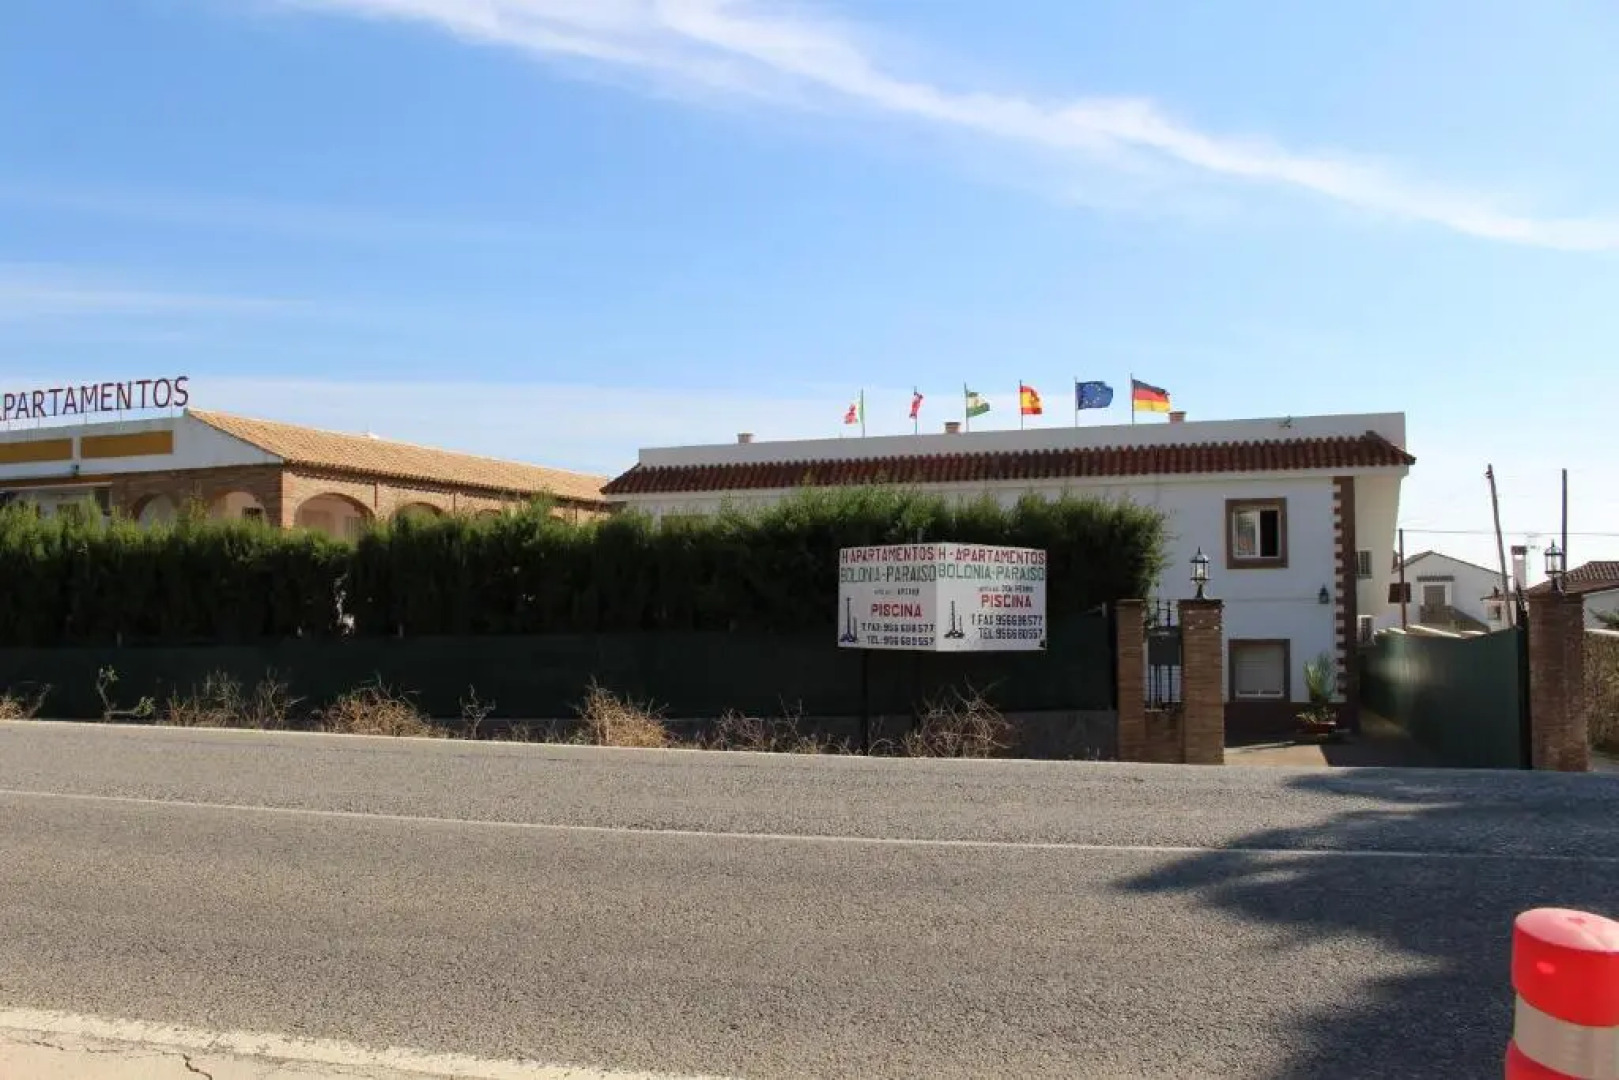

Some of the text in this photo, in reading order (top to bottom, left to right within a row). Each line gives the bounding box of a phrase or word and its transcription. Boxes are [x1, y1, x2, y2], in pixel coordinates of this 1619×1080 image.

[0, 376, 189, 421] PARTAMENTOS
[850, 547, 934, 563] APARTAMENTOS
[955, 548, 1045, 565] APARTAMENTOS
[981, 594, 1032, 608] PISCINA
[871, 604, 923, 618] PISCINA
